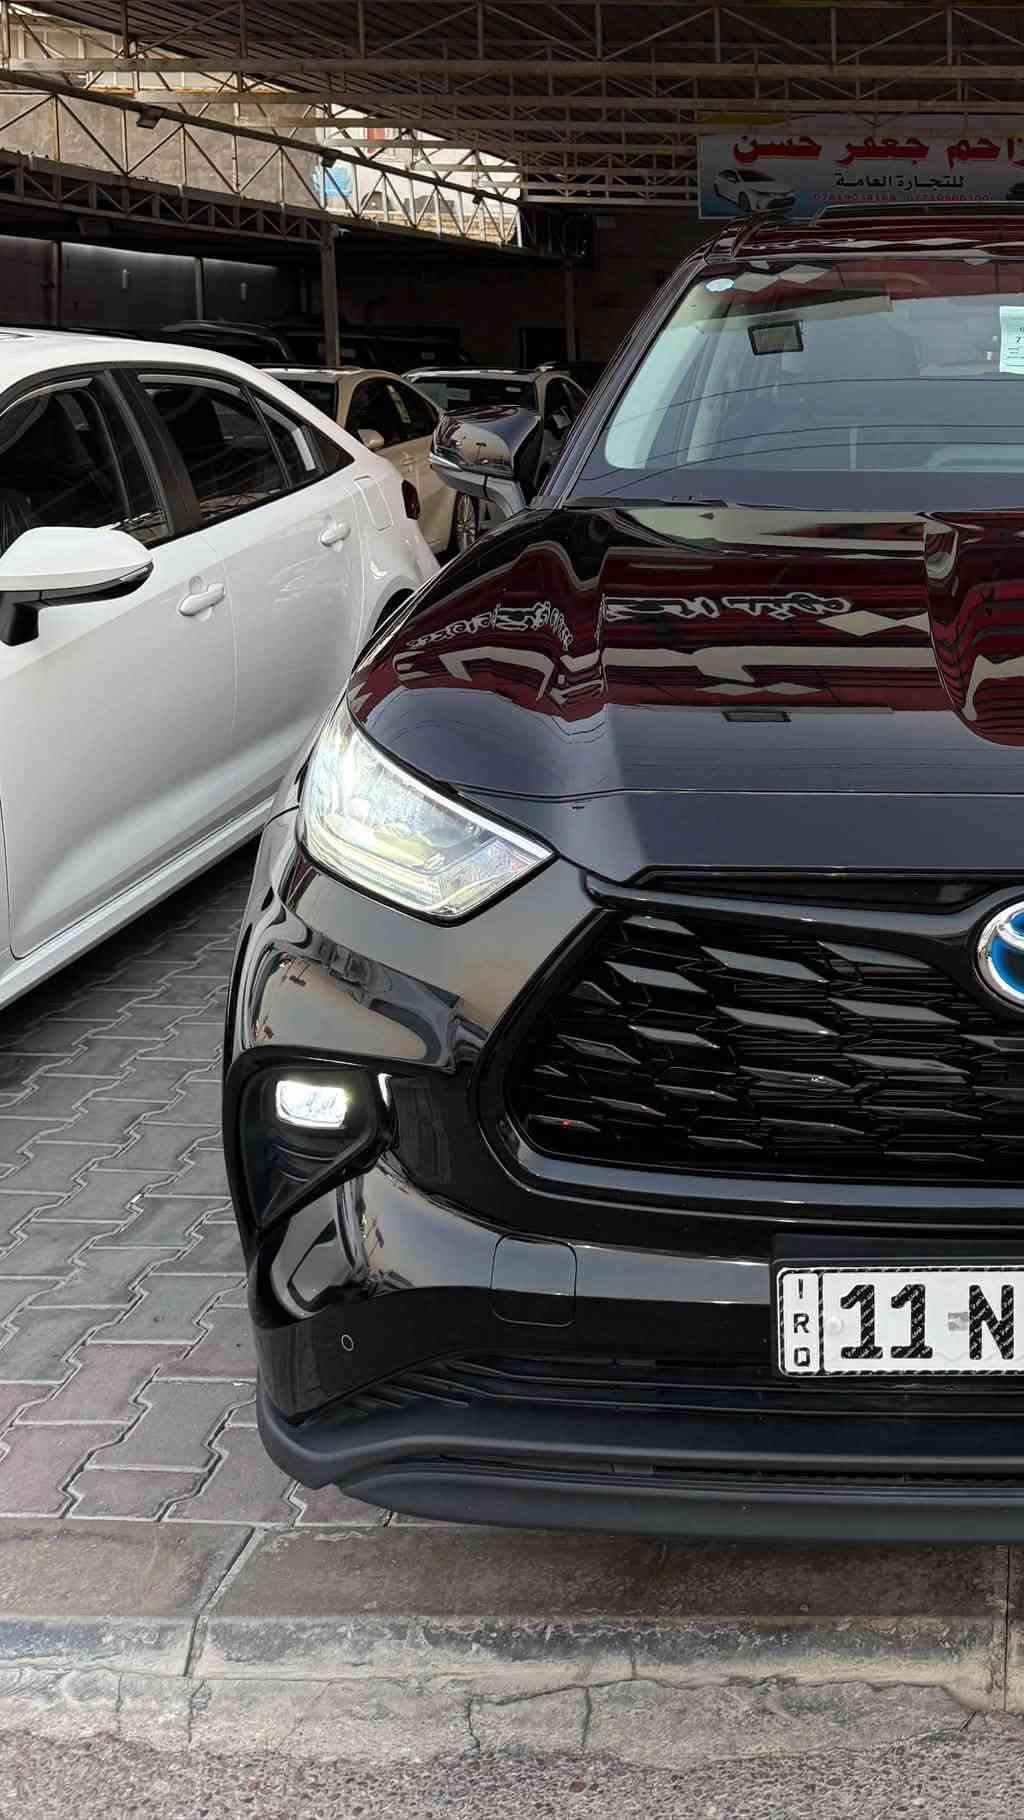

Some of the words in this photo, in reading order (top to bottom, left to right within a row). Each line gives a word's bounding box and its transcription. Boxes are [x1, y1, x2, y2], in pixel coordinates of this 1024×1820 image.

[732, 135, 822, 164] حسن
[836, 135, 930, 165] جعفر
[839, 1283, 934, 1360] 11
[968, 1284, 1015, 1360] N
